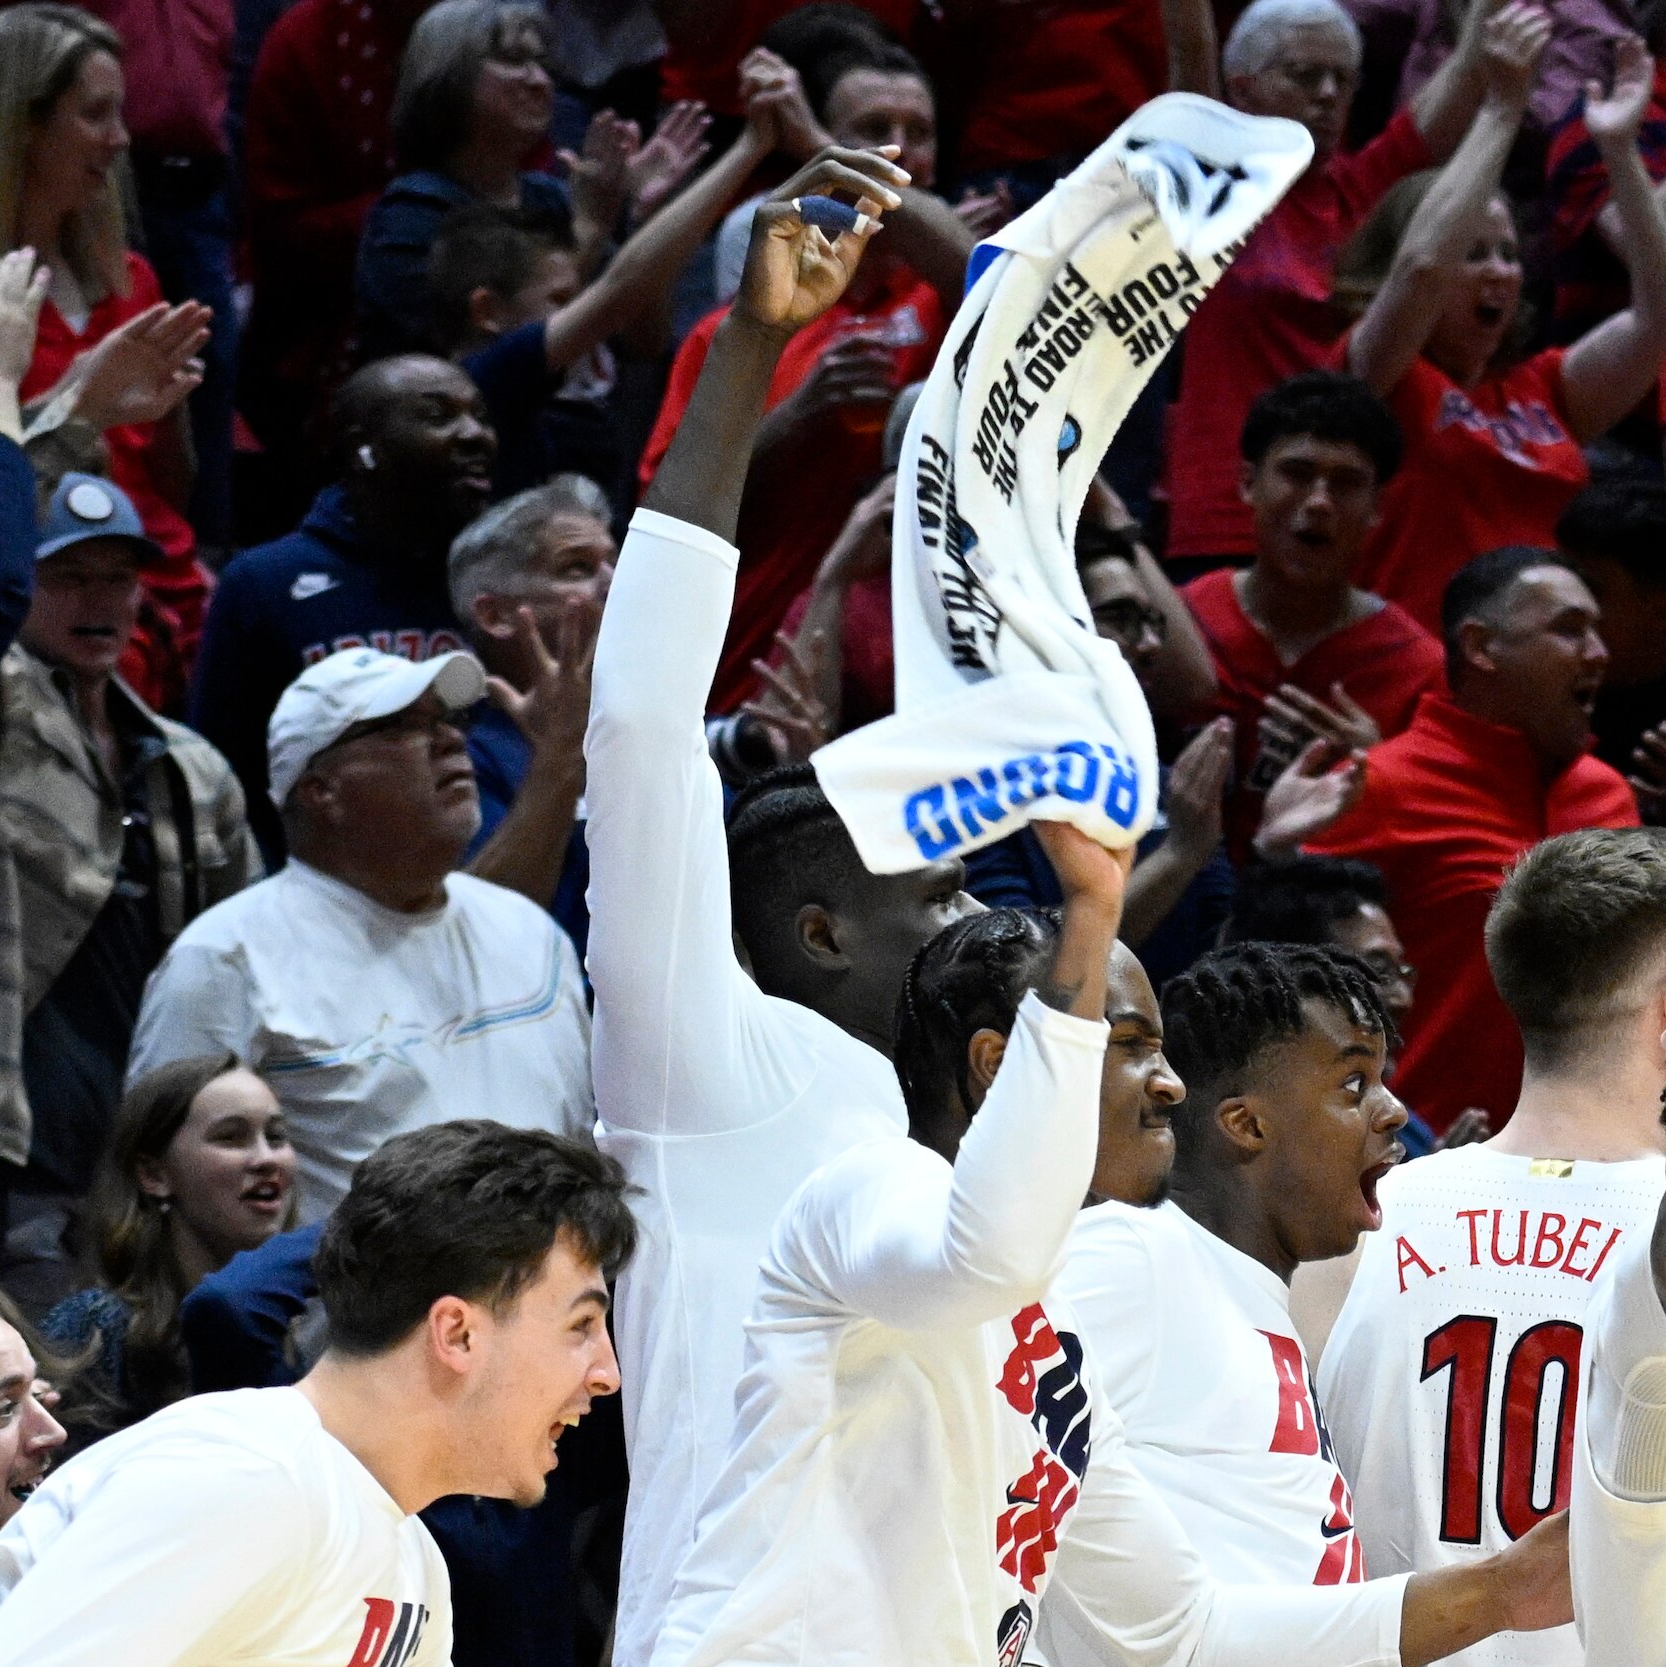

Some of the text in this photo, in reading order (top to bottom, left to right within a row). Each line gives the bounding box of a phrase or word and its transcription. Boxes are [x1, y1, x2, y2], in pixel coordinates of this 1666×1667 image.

[1105, 250, 1202, 338] FOUR
[1023, 304, 1097, 393] ROAD
[1123, 313, 1179, 368] THE
[971, 358, 1025, 477] FOUR
[904, 740, 1141, 862] ROUND
[1396, 1235, 1446, 1294] A.
[1420, 1314, 1583, 1544] 10
